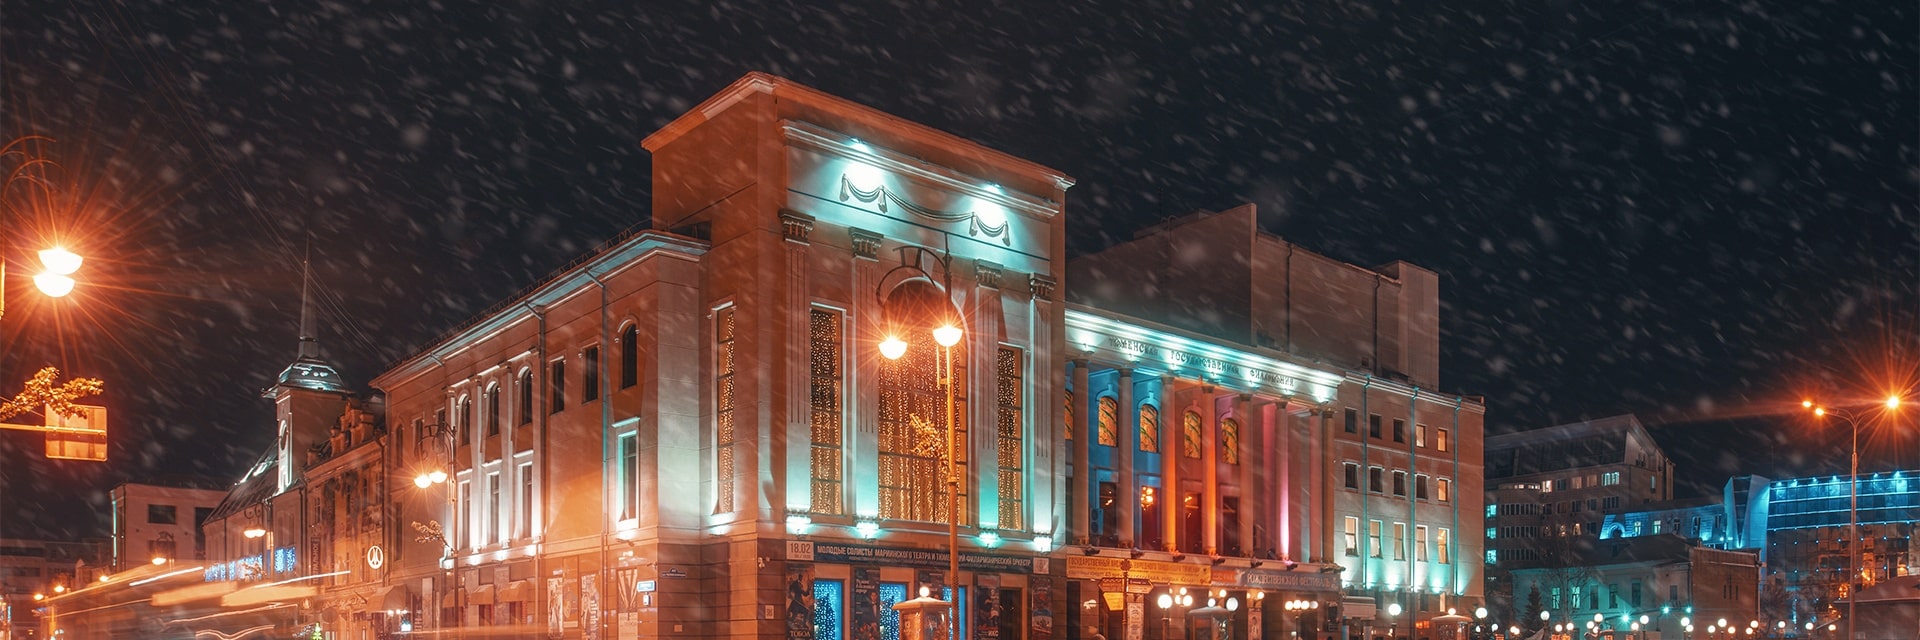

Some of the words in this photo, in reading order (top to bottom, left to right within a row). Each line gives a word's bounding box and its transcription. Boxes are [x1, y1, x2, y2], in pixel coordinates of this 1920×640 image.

[790, 543, 811, 554] 18.02
[817, 545, 847, 556] МОЛОДЫЕ
[847, 547, 873, 557] СОЛИСТЫ
[875, 549, 912, 559] МАРИИНСКОГО
[913, 552, 931, 560] ТЕАТРА
[1013, 558, 1031, 567] ОРКЕСТР
